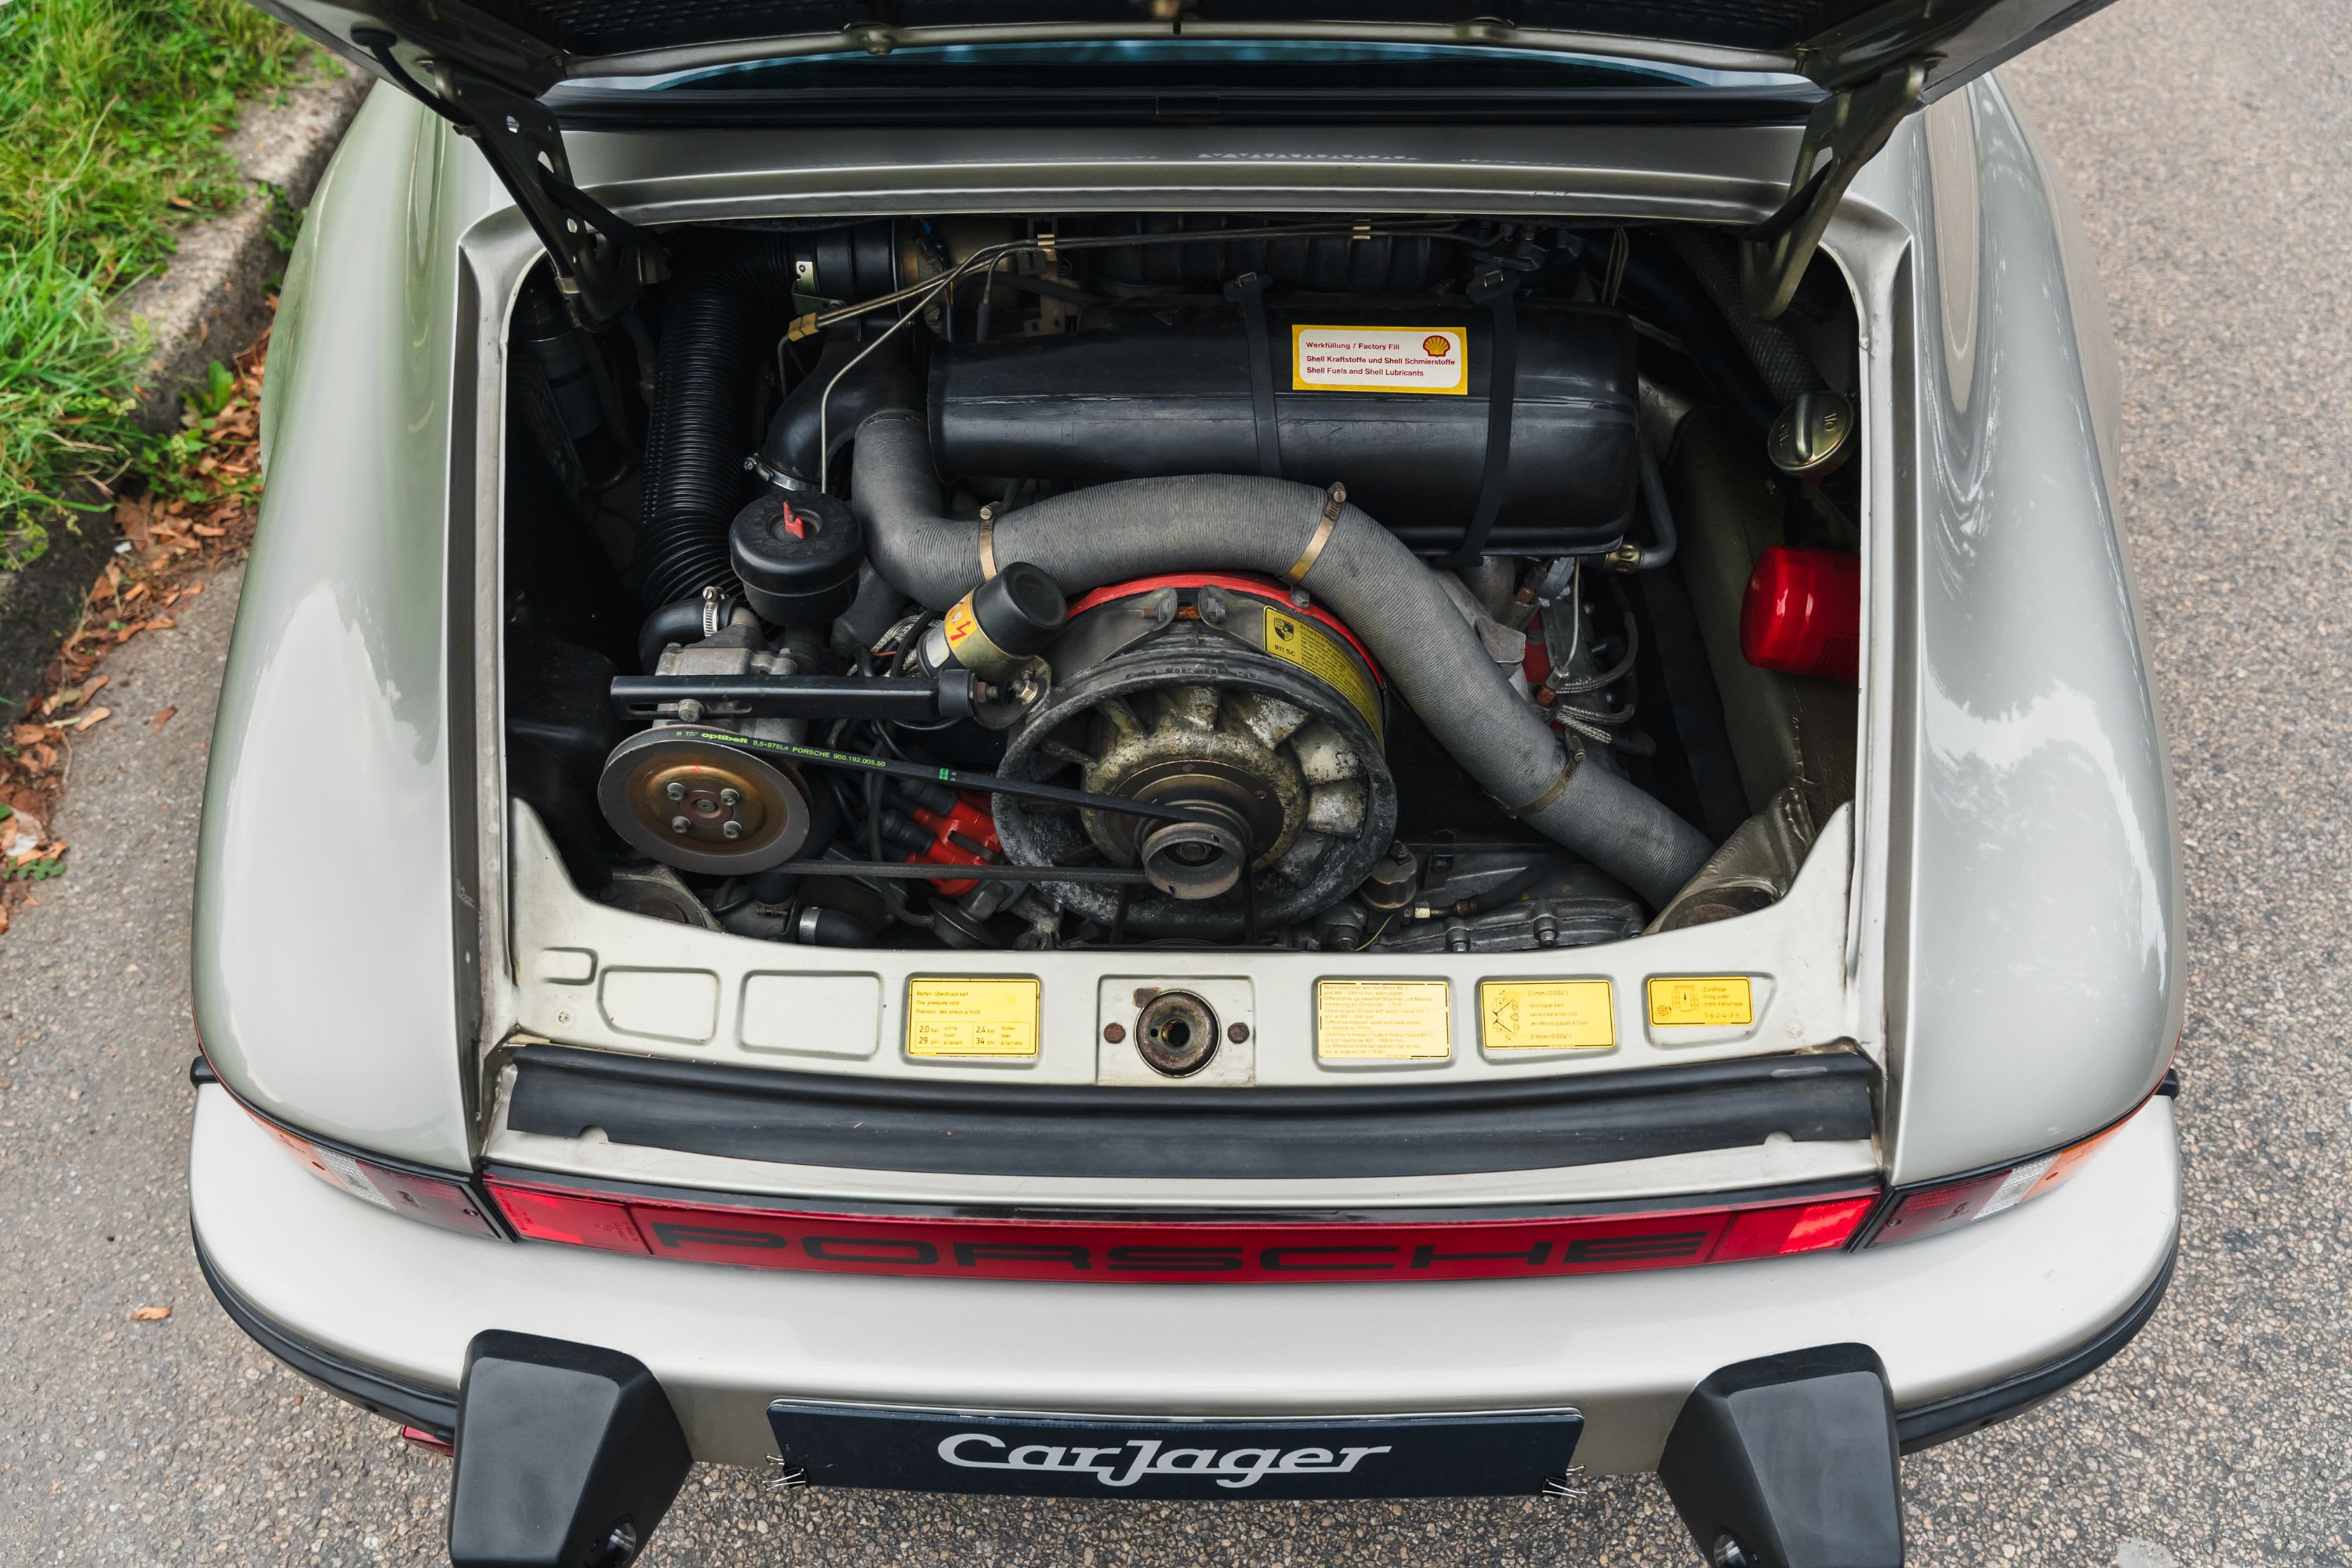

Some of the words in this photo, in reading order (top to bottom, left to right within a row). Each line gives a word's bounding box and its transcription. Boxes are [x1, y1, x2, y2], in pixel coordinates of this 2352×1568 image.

[1306, 342, 1350, 350] Werkfüllung
[1358, 343, 1387, 351] Factory
[1274, 644, 1285, 653] 911
[1286, 648, 1296, 657] SC
[792, 746, 830, 758] PORSCHE
[833, 754, 886, 767] 900.192.005.50
[652, 1222, 1708, 1272] PORSCHE
[938, 1433, 1392, 1487] CarJager
